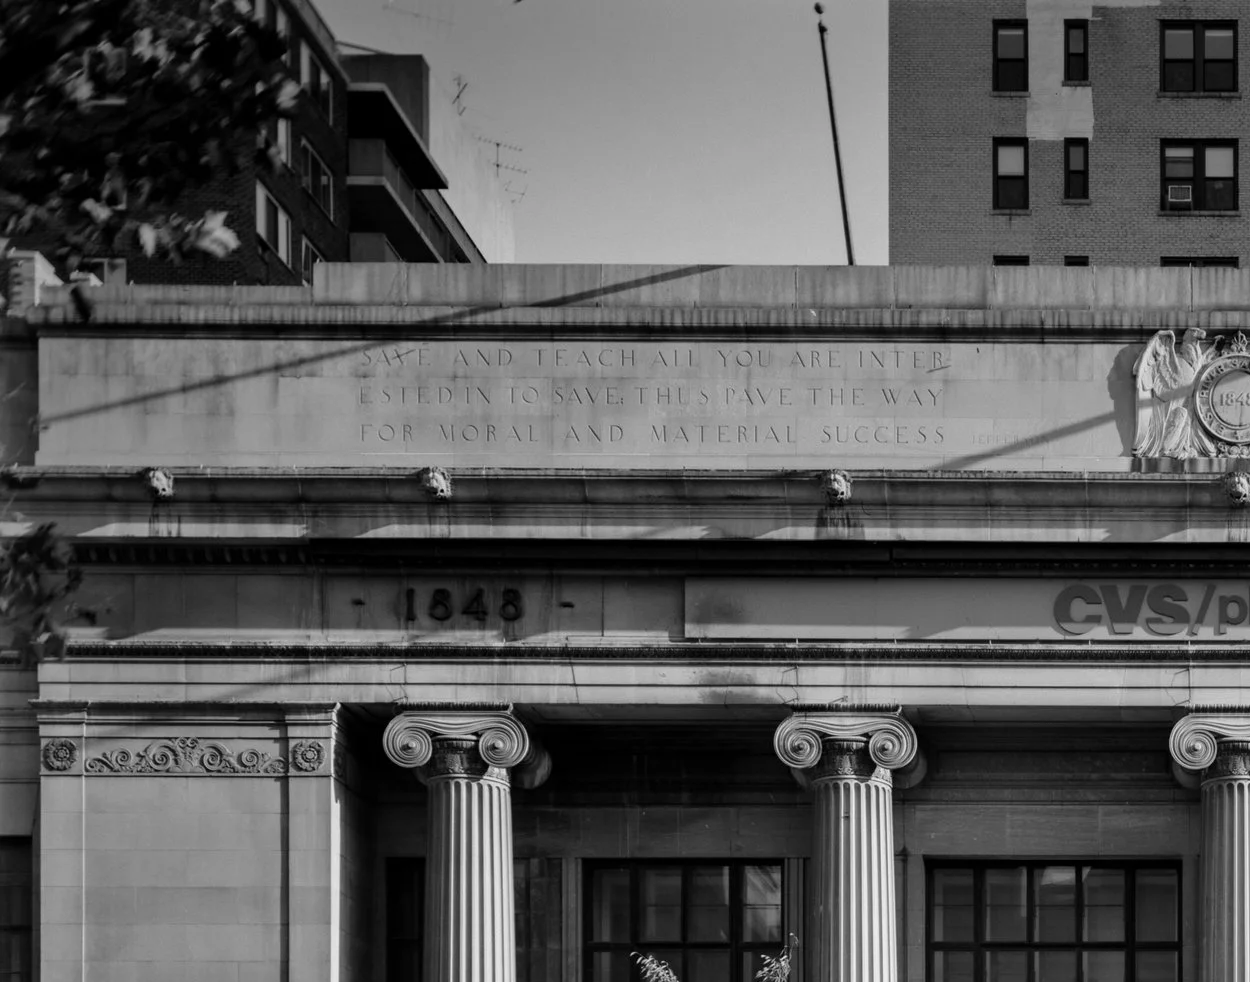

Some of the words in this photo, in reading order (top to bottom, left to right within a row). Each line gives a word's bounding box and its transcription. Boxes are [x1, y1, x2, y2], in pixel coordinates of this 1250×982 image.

[361, 348, 431, 368] SAVE
[453, 348, 513, 368] AND
[535, 348, 636, 368] TEACH
[652, 348, 700, 368] ALL
[716, 348, 772, 368] YOU
[788, 348, 841, 368] ARE
[359, 386, 453, 405] ESTED
[466, 386, 491, 405] IN
[507, 386, 540, 405] TO
[634, 386, 709, 405] THUS
[725, 386, 793, 405] PAVE
[807, 386, 865, 405] THE
[881, 386, 943, 405] WAY
[361, 424, 414, 443] FOR
[439, 424, 538, 443] MORAL
[565, 424, 624, 443] AND
[651, 424, 797, 443] MATERIAL
[821, 424, 945, 443] SUCCESS
[403, 587, 525, 621] 1848
